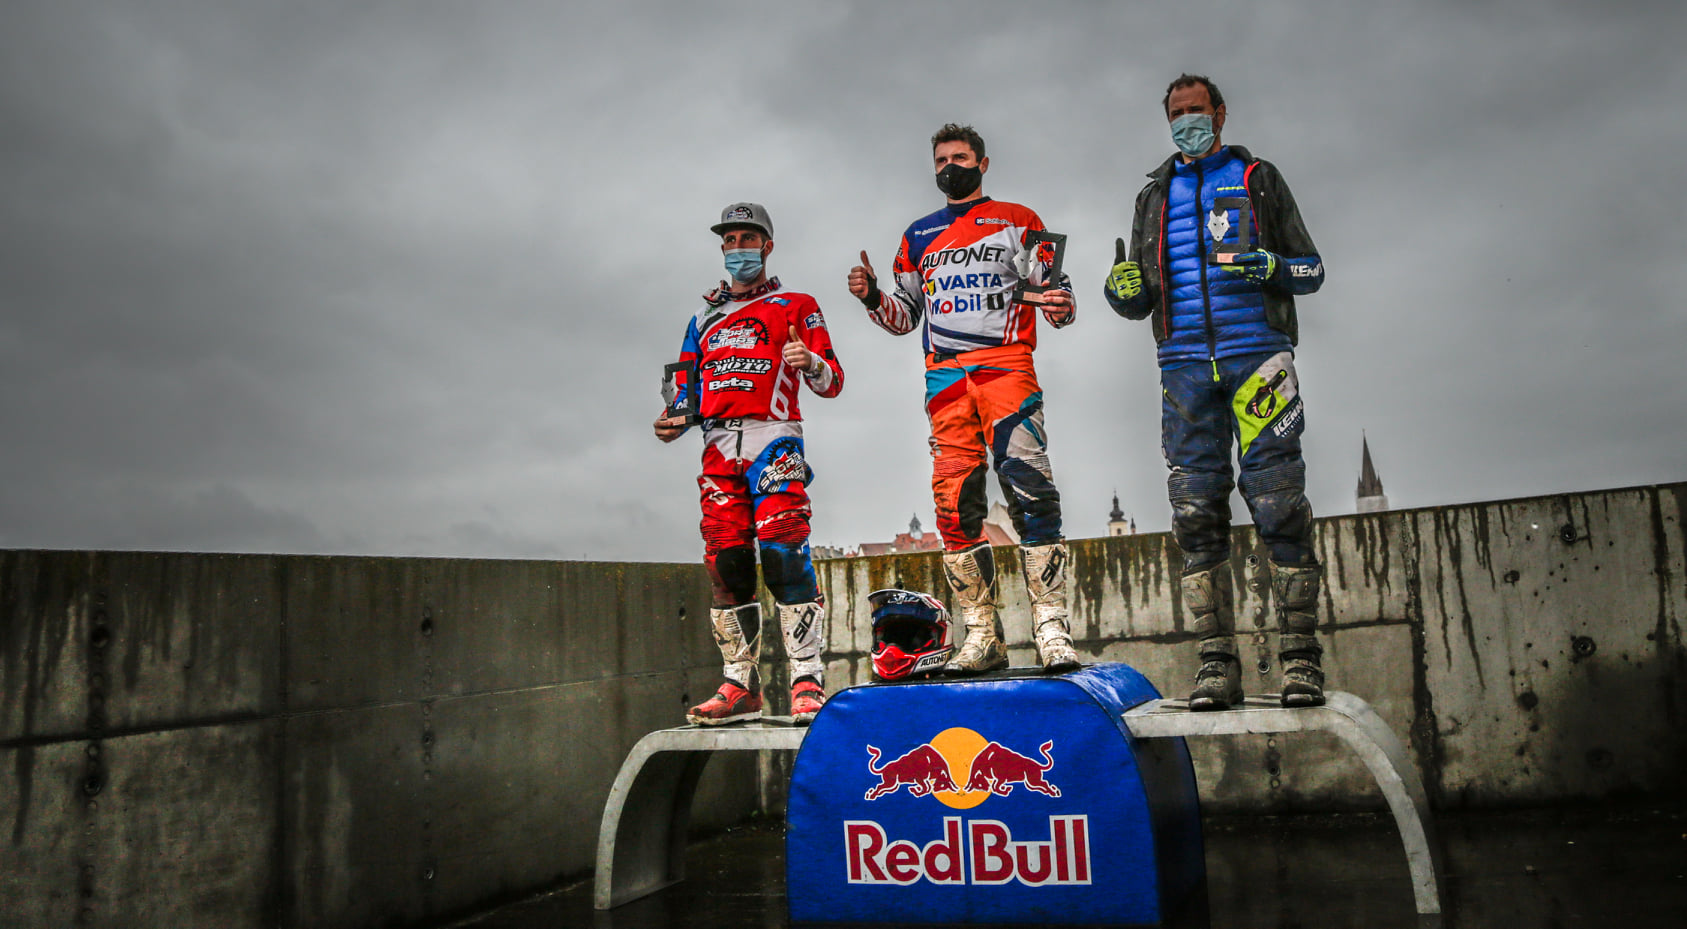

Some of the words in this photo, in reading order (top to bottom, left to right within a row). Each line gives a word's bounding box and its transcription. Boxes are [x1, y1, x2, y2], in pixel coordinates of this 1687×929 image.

[938, 273, 1003, 291] VARTA
[932, 294, 981, 315] Mobil
[714, 361, 772, 374] MOTO
[708, 377, 754, 391] Beta
[844, 816, 966, 886] Red
[968, 815, 1092, 887] Bull
